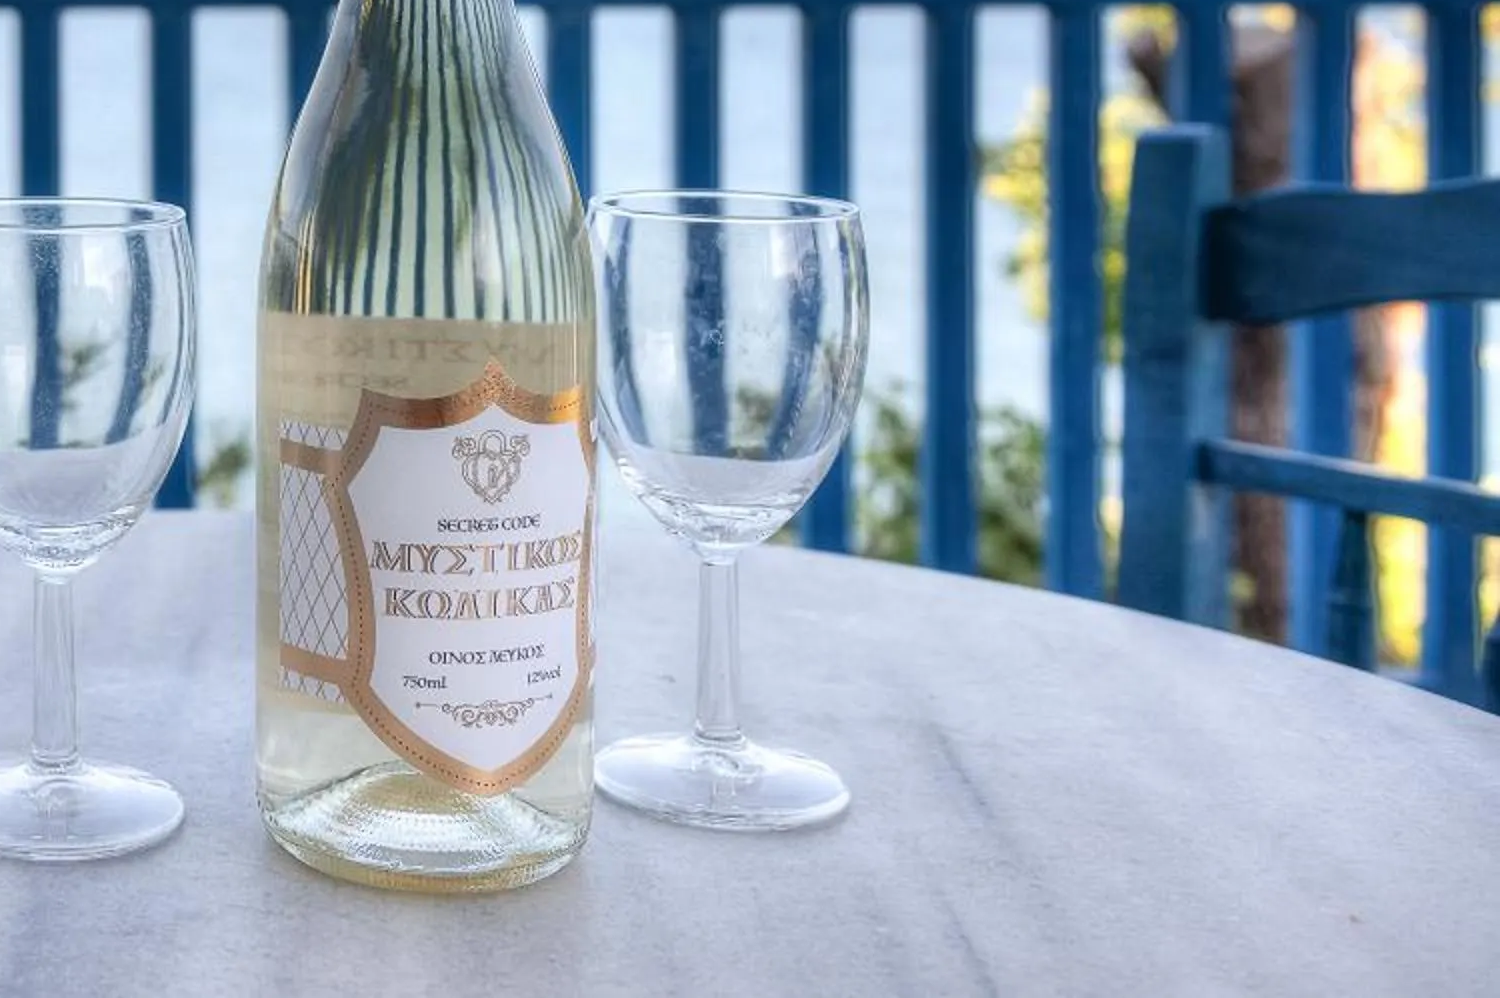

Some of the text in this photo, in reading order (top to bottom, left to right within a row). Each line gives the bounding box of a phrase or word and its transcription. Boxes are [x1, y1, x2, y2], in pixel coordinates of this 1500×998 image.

[437, 513, 541, 533] SECRET CODE
[370, 530, 582, 575] ΜΥΣΤΙΚΟΣ
[429, 643, 546, 665] ΟΙΝΟΣ ΛΕΥΚΟΣ
[403, 674, 448, 690] 750ml
